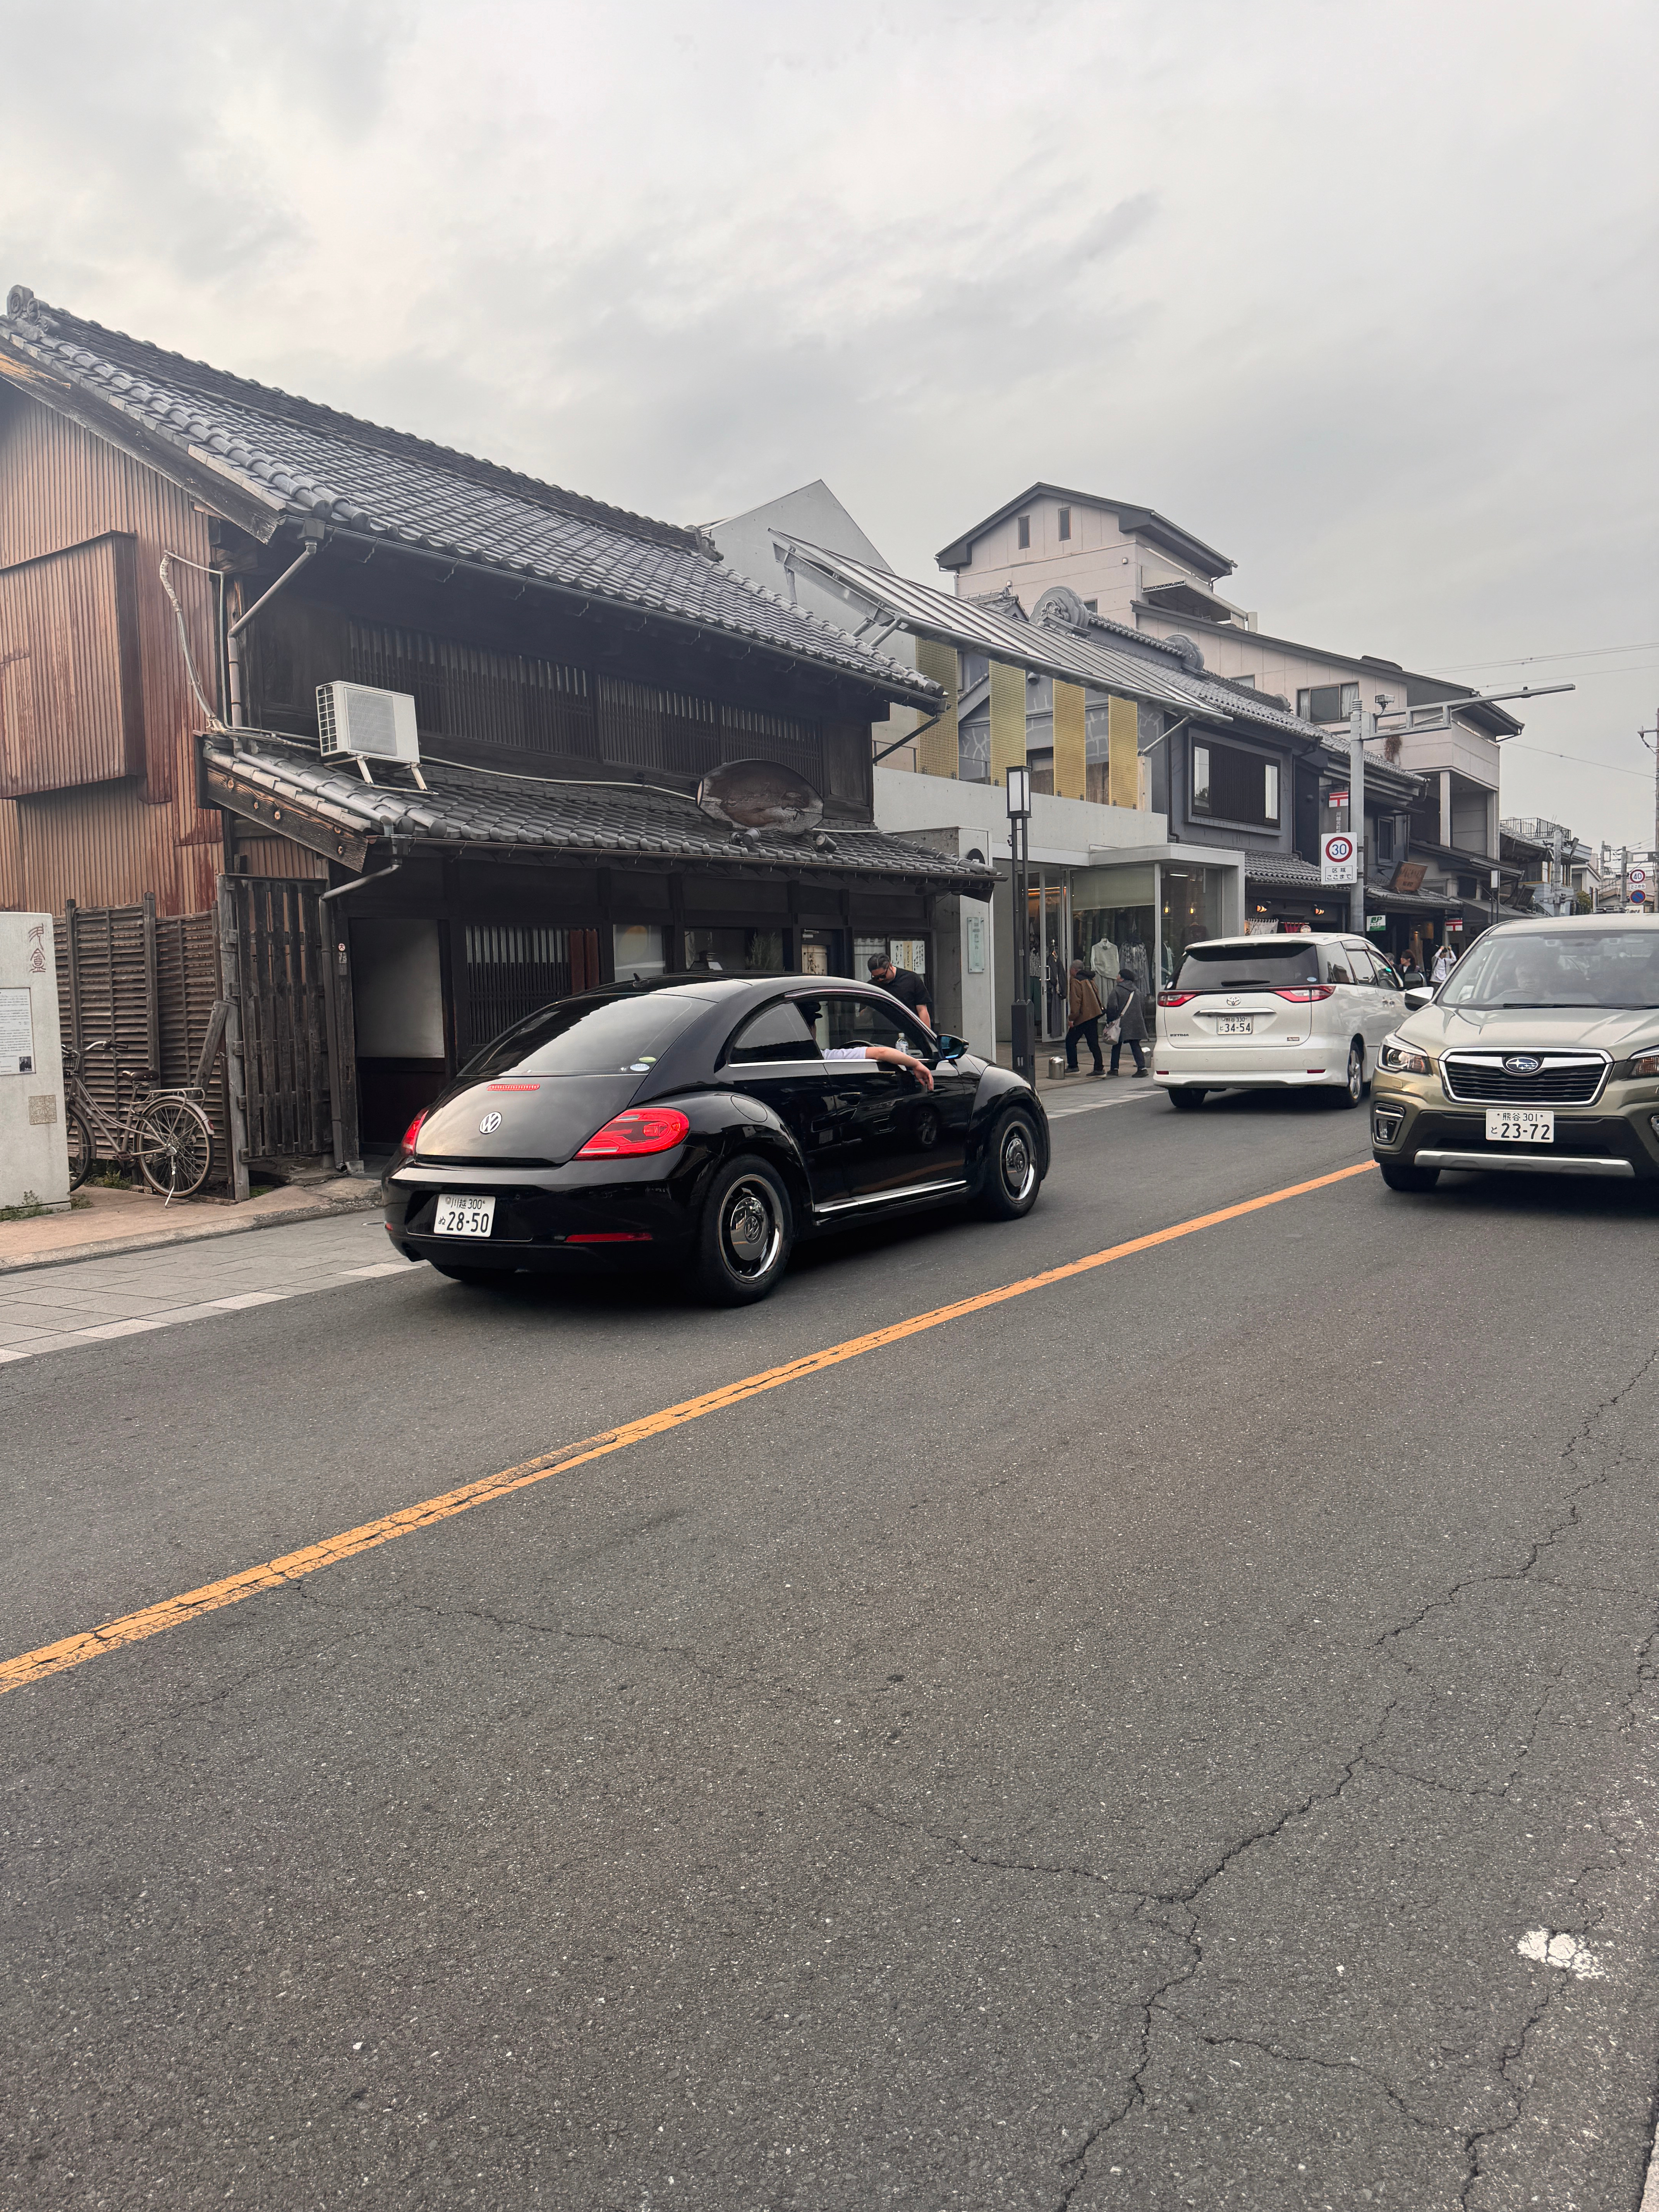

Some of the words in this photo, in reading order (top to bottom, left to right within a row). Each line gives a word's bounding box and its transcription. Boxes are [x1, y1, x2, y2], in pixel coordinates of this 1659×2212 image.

[1332, 843, 1347, 855] 30
[1225, 1023, 1250, 1032] 34-54
[1503, 1113, 1521, 1121] 熊谷
[1522, 1113, 1537, 1121] 301
[1501, 1123, 1550, 1140] 23-72
[451, 1198, 466, 1209] 川越
[467, 1199, 482, 1209] 300
[447, 1211, 489, 1233] 28-50
